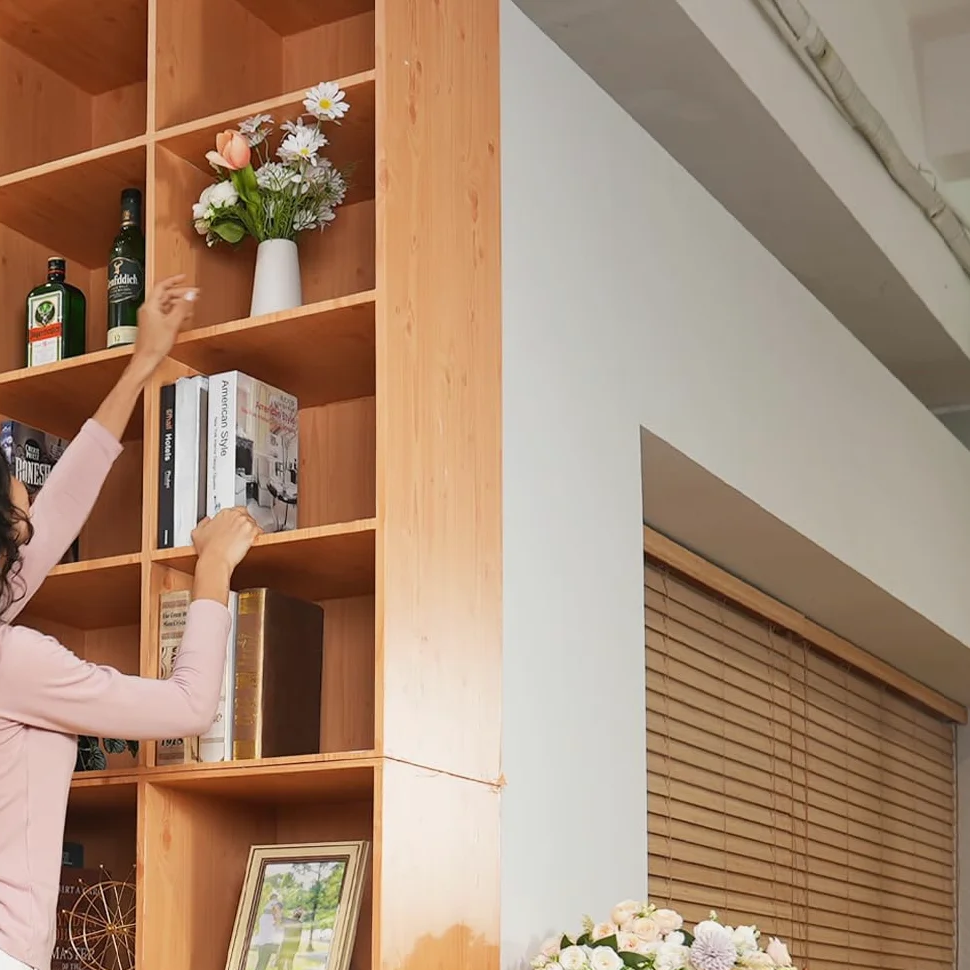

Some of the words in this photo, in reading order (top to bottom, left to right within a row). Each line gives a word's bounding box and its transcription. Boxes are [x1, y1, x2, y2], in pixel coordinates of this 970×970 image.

[220, 380, 229, 429] American
[164, 433, 173, 461] Hotels
[218, 431, 229, 457] Style
